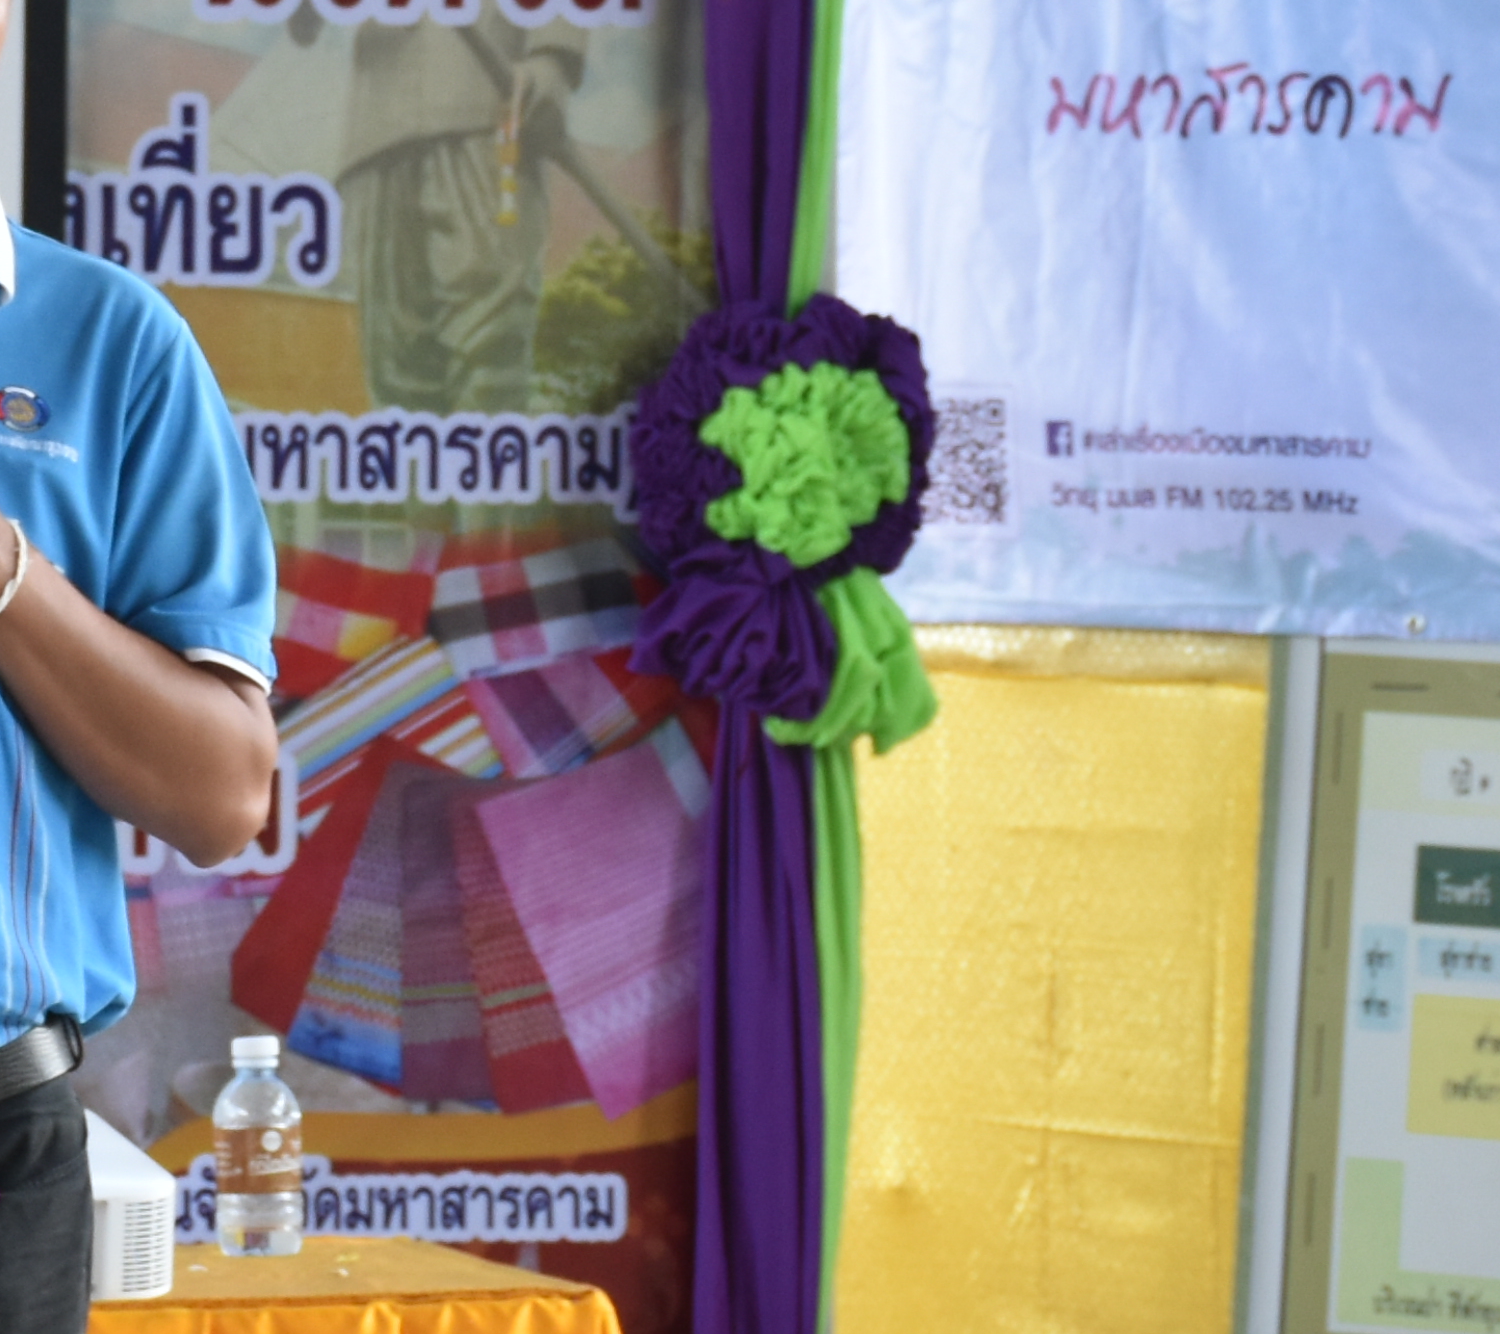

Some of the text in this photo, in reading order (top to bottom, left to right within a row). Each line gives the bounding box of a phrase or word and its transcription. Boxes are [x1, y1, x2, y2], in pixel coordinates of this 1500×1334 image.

[1047, 63, 1452, 141] มหาสารคาม
[246, 420, 623, 491] หาสารคาม
[1165, 485, 1204, 509] FM
[1214, 487, 1294, 514] 102.25
[1303, 490, 1360, 515] MHz
